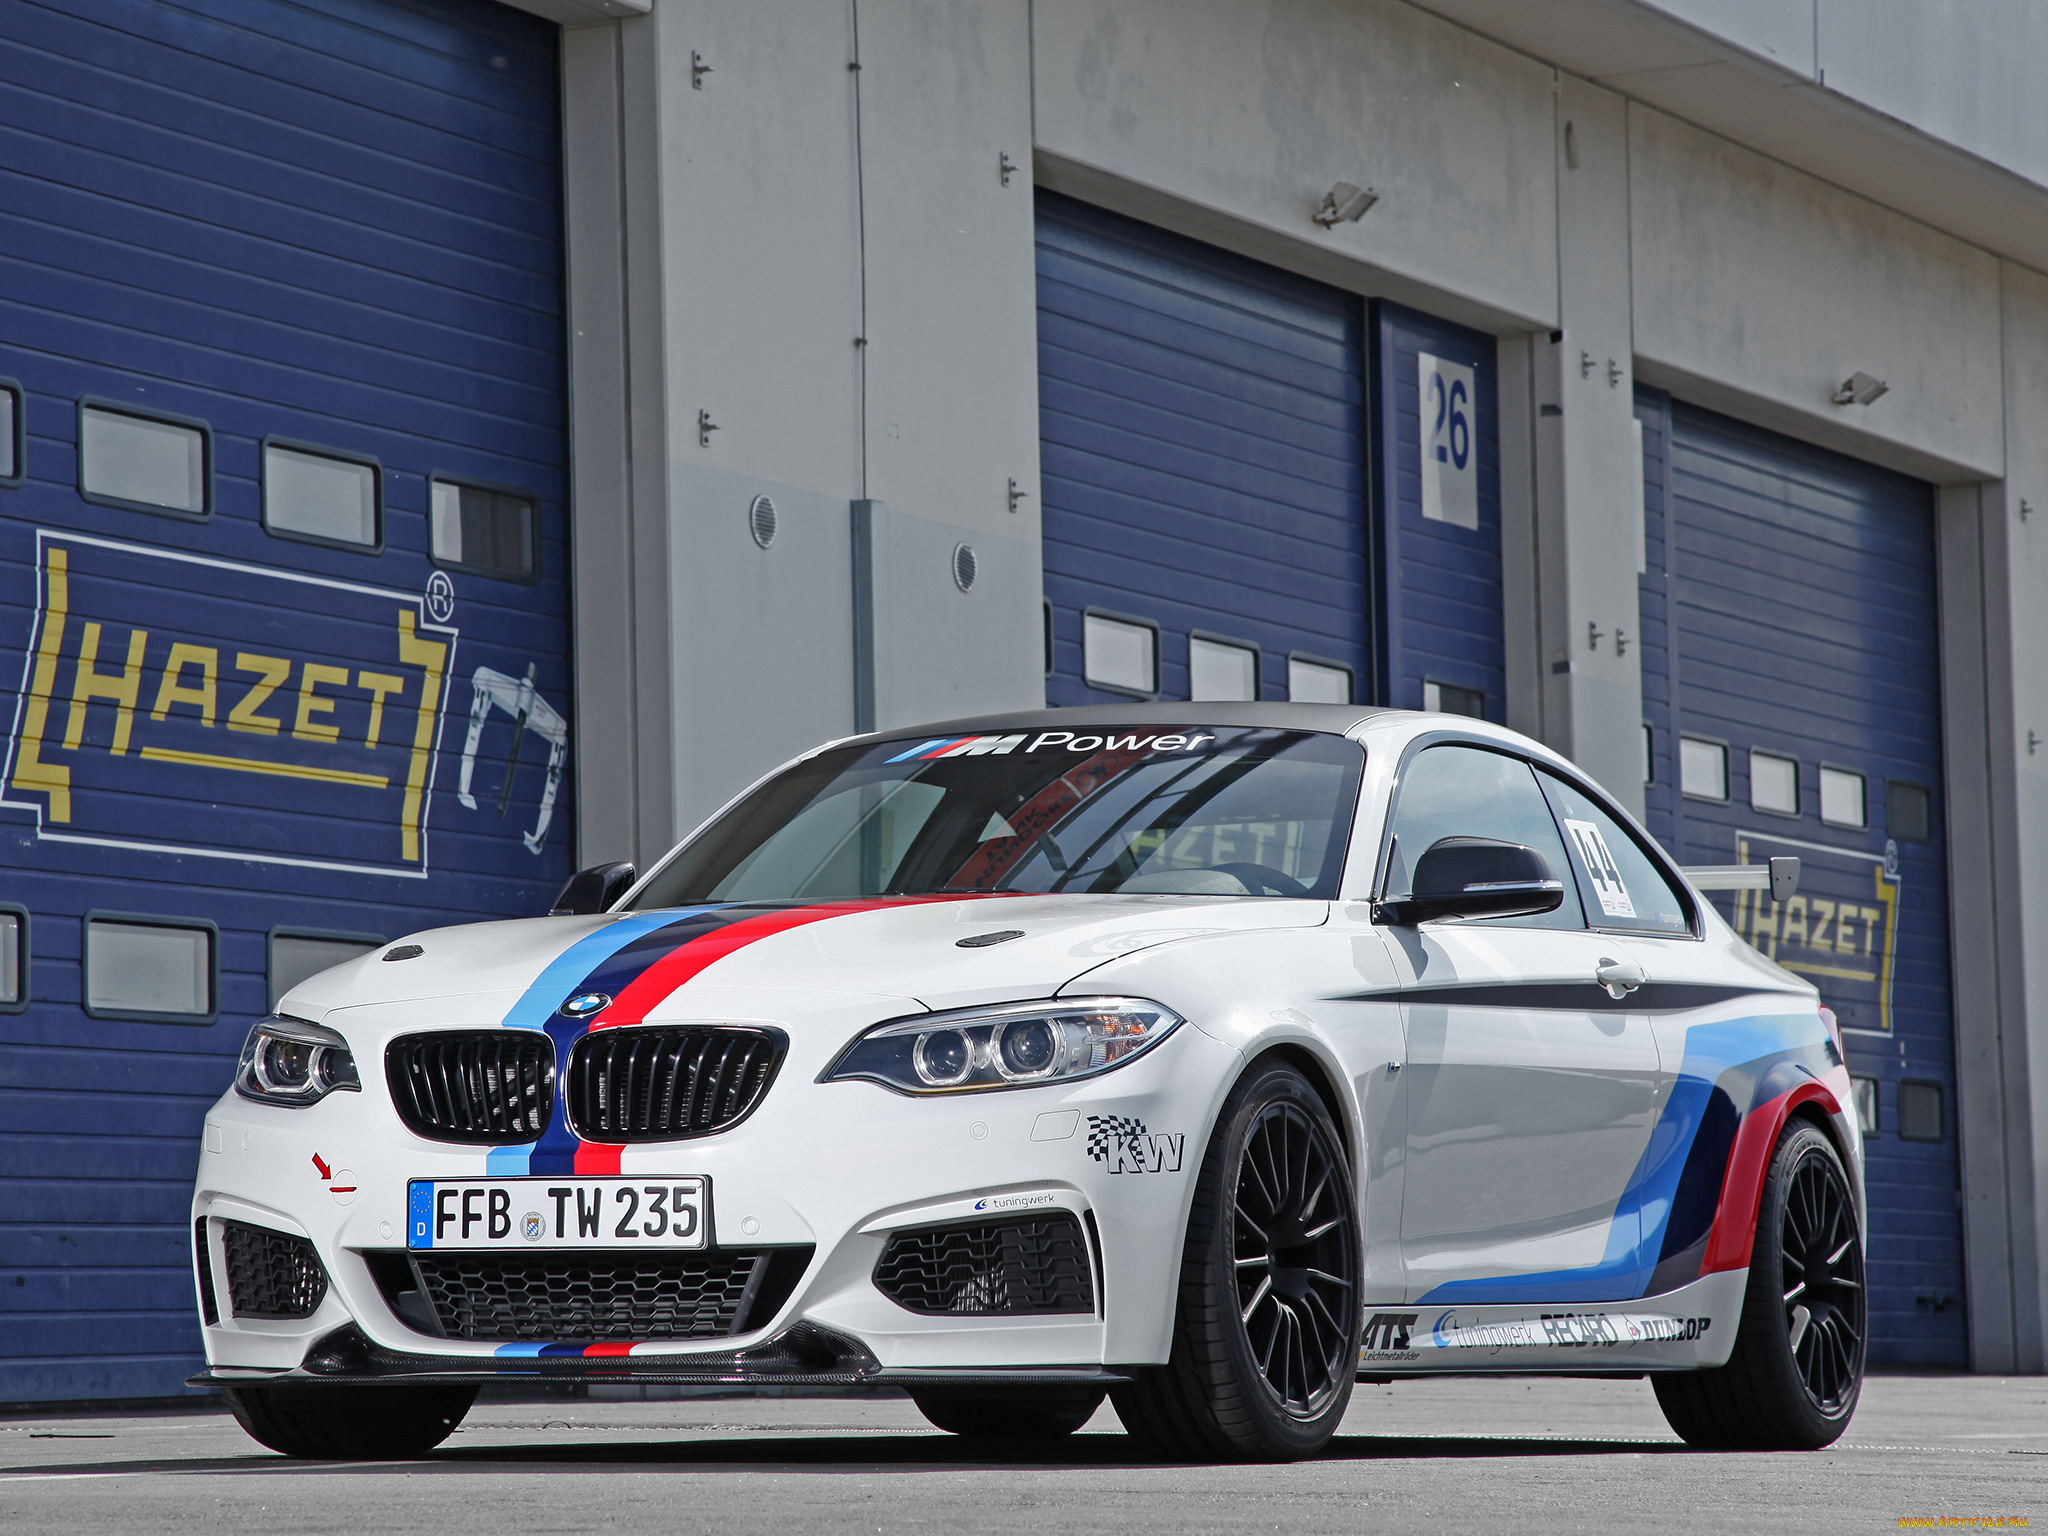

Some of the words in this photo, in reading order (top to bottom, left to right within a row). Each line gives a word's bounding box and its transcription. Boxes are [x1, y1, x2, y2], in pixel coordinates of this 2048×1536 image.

[1427, 371, 1470, 470] 26
[62, 621, 404, 756] HAZET
[1025, 731, 1216, 754] Power
[1573, 828, 1625, 893] 44
[1752, 889, 1881, 961] HAZET
[1107, 1133, 1185, 1174] KW
[436, 1188, 512, 1239] FFB
[548, 1187, 602, 1239] TW
[615, 1186, 698, 1238] 235
[993, 1193, 1056, 1209] tuningwerk
[417, 1222, 426, 1236] D
[1361, 1313, 1419, 1350] ATS
[1453, 1317, 1537, 1356] tuningwerk
[1540, 1313, 1619, 1347] RECARO
[1640, 1317, 1712, 1342] DUNLOP
